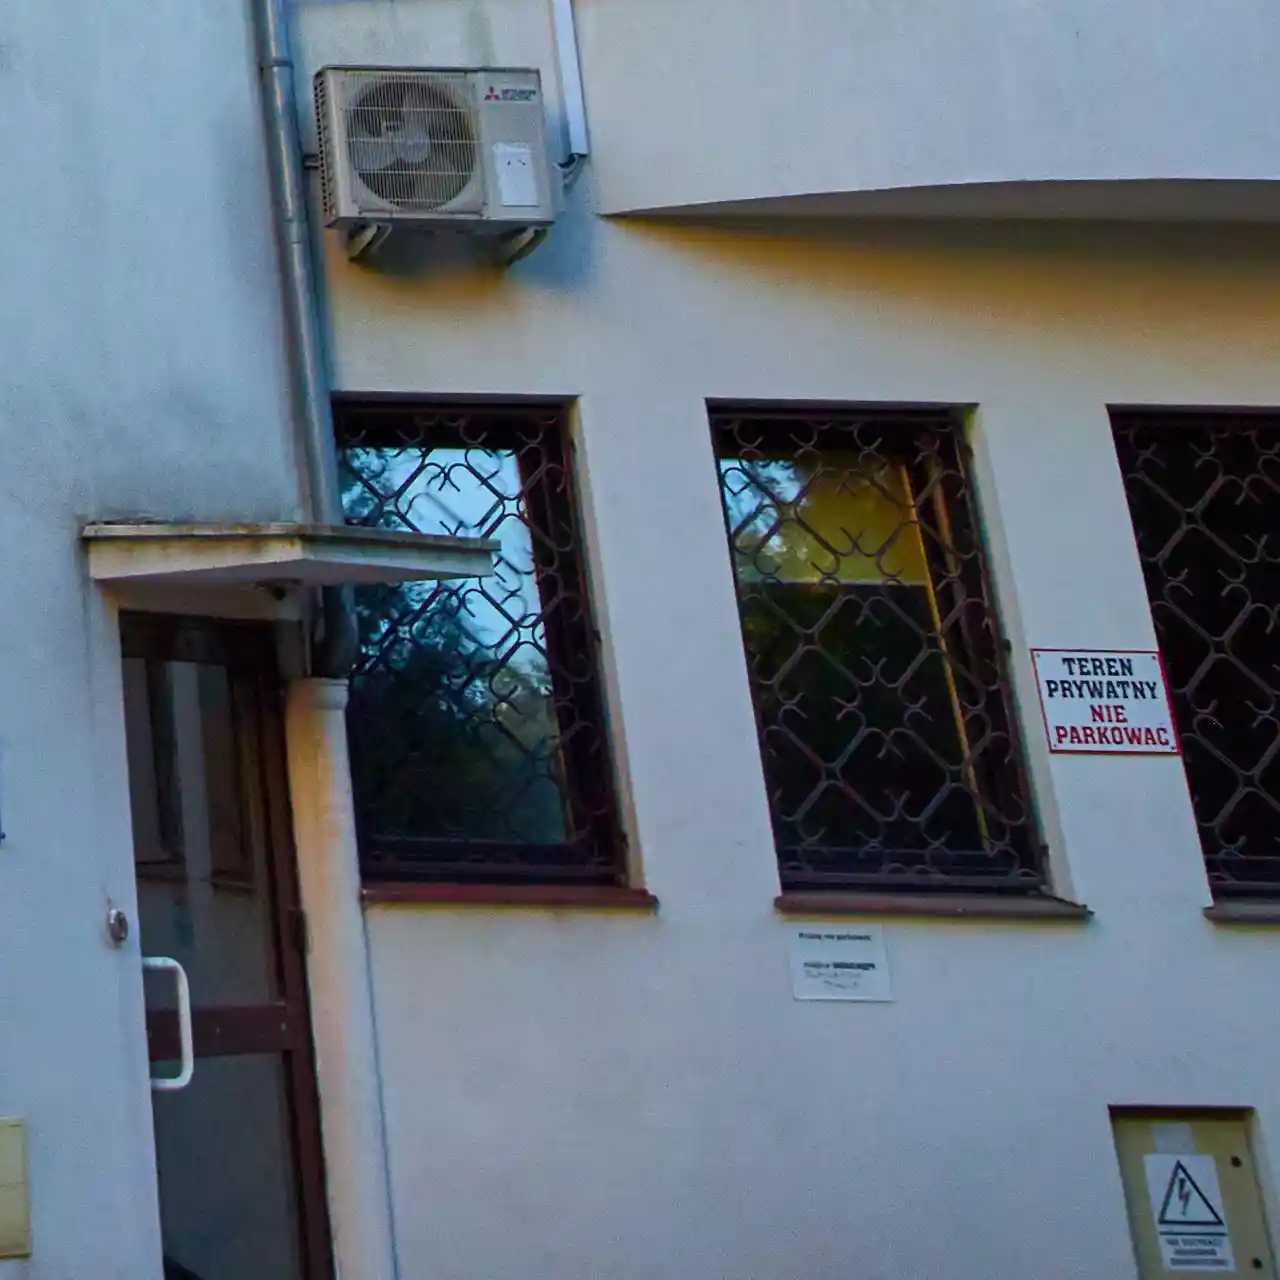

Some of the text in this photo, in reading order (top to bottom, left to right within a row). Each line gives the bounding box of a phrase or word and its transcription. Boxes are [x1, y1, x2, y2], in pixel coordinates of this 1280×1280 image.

[1062, 657, 1134, 677] TEREN
[1045, 679, 1159, 699] PRYWATNY
[1089, 704, 1128, 724] NIE
[1054, 722, 1170, 746] PARKOWAĆ
